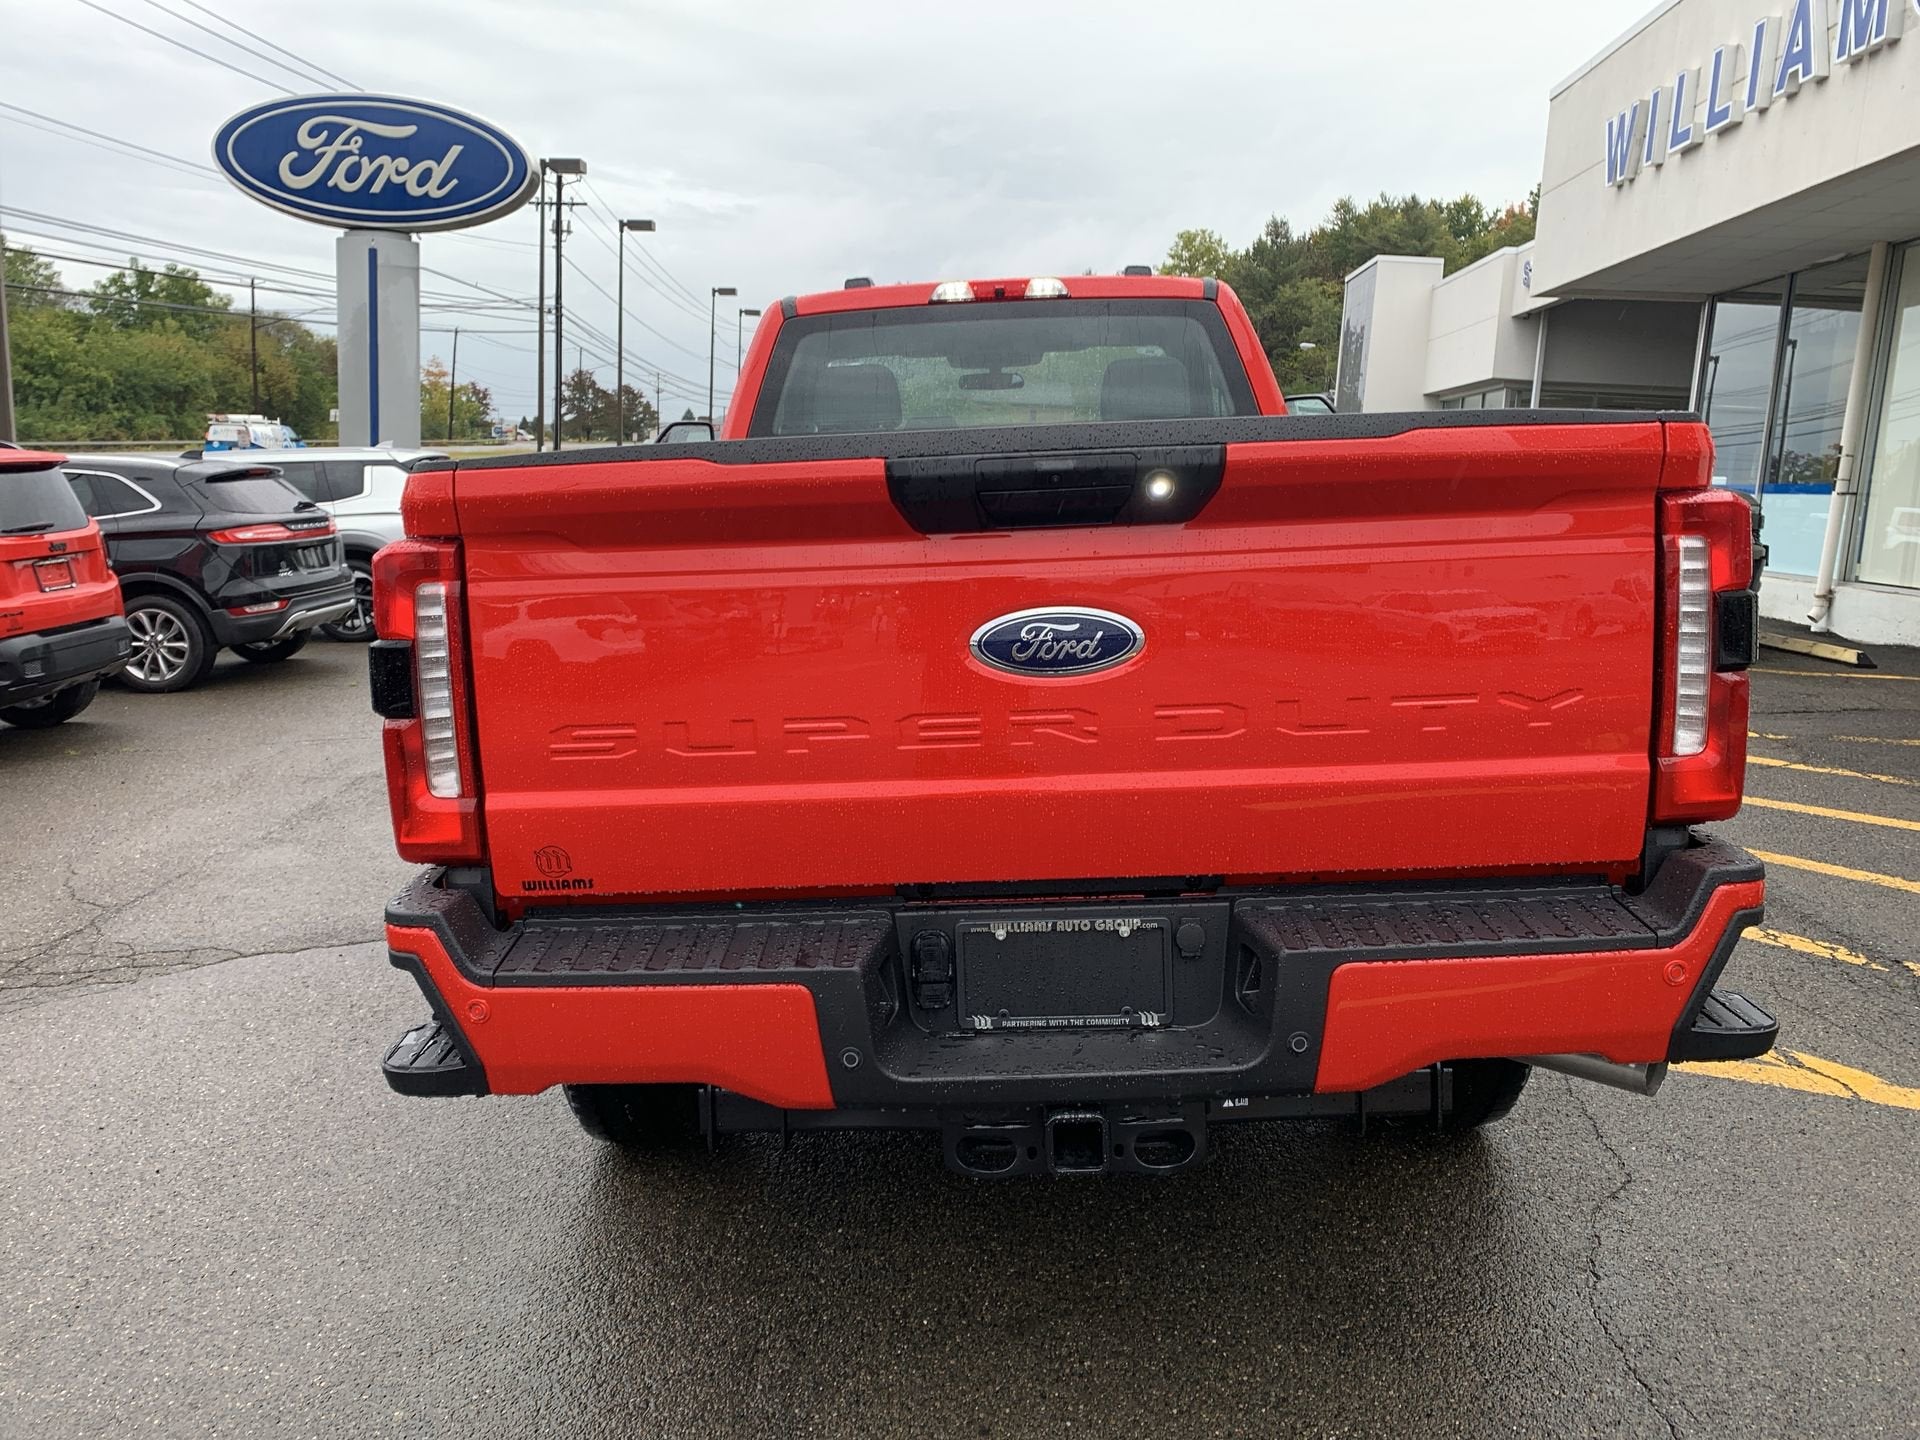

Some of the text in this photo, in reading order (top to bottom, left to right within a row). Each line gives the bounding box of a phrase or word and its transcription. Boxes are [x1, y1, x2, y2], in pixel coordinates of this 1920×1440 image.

[278, 114, 465, 199] Ford
[1011, 622, 1105, 662] Ford
[549, 687, 1585, 761] SUPER DUTY
[521, 878, 594, 892] WILLIAMS
[1056, 919, 1091, 932] AUTO
[1002, 1017, 1130, 1028] PARTNERING WITH THE COMMUNITY
